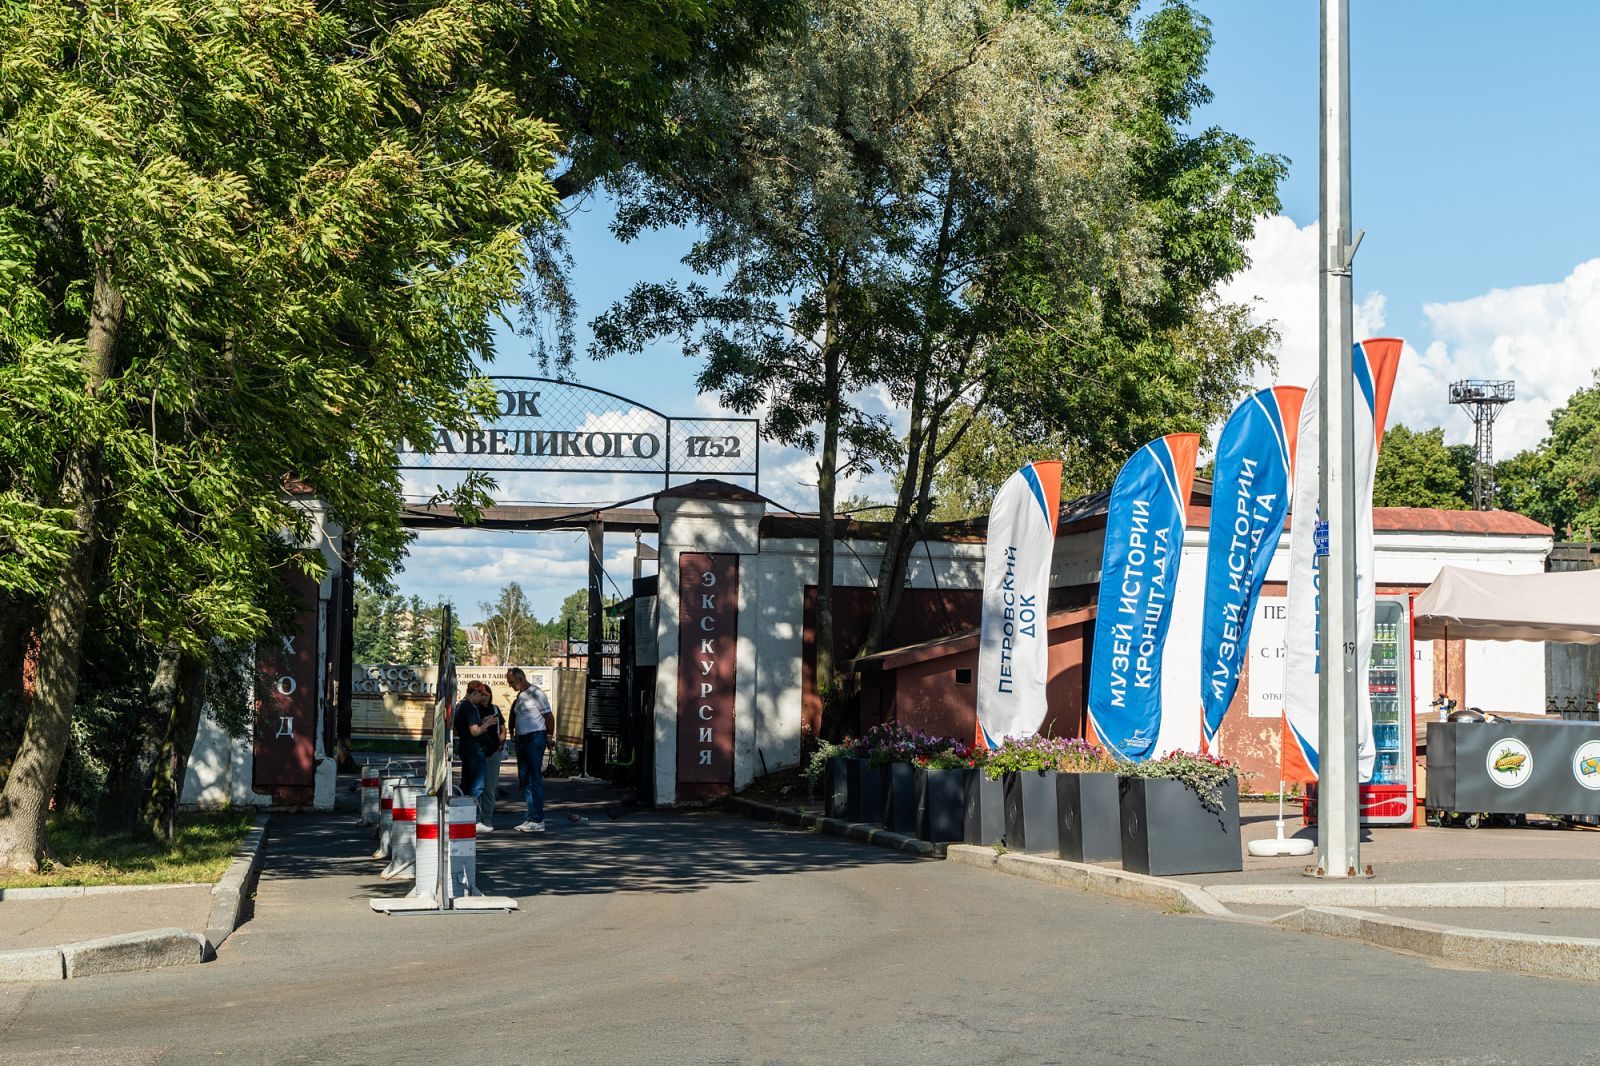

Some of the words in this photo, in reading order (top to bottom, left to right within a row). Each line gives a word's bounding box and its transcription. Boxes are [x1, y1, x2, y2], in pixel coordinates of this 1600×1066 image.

[480, 389, 541, 417] ОК
[466, 428, 660, 459] ВЕЛИКОГО
[686, 435, 741, 458] 1752
[1119, 499, 1151, 614] ИСТОРИИ
[1211, 602, 1242, 702] МУЗЕЙ
[1227, 457, 1258, 592] ИСТОРИИ
[998, 545, 1018, 694] ПЕТРОВСКИЙ
[1019, 593, 1036, 638] ДОК
[1134, 526, 1170, 688] КРОНШТАДТА
[1264, 605, 1287, 620] ПЕ
[362, 668, 420, 681] КАССА
[698, 571, 717, 765] ЭКСКУРСИЯ
[1110, 625, 1134, 708] МУЗЕЙ
[1343, 641, 1355, 656] 19
[276, 634, 298, 739] ХОД
